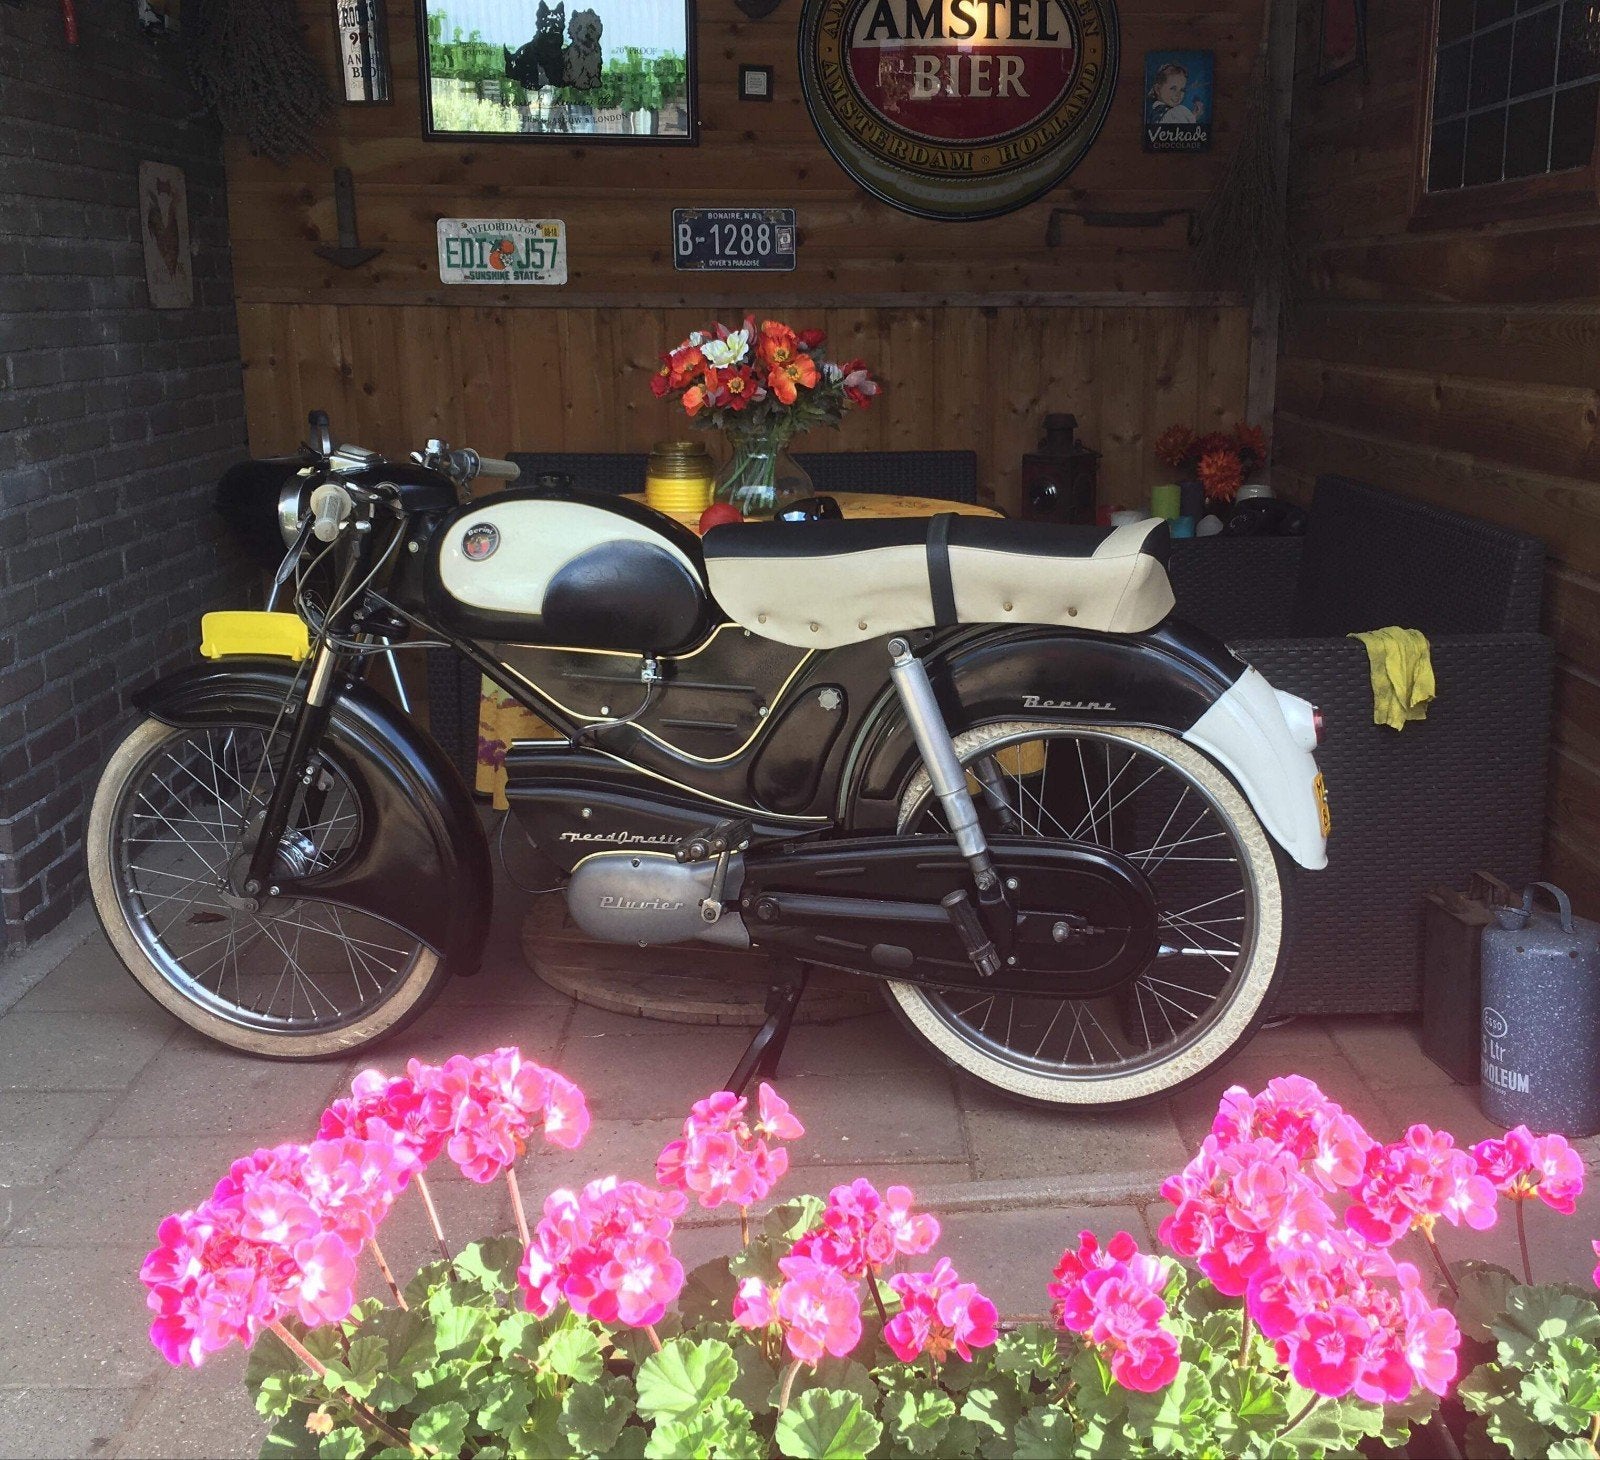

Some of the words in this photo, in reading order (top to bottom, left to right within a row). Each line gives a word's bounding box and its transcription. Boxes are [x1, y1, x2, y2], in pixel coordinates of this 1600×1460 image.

[862, 0, 1060, 41] AMSTEL
[911, 54, 1031, 100] BIER
[592, 112, 628, 124] LONDON
[820, 58, 973, 170] AMSTERDAM
[997, 62, 1098, 166] HOLLAND
[1147, 125, 1208, 143] Verkade
[678, 223, 772, 256] B-1288
[469, 270, 511, 281] SUNSHINE
[513, 270, 540, 281] STATE
